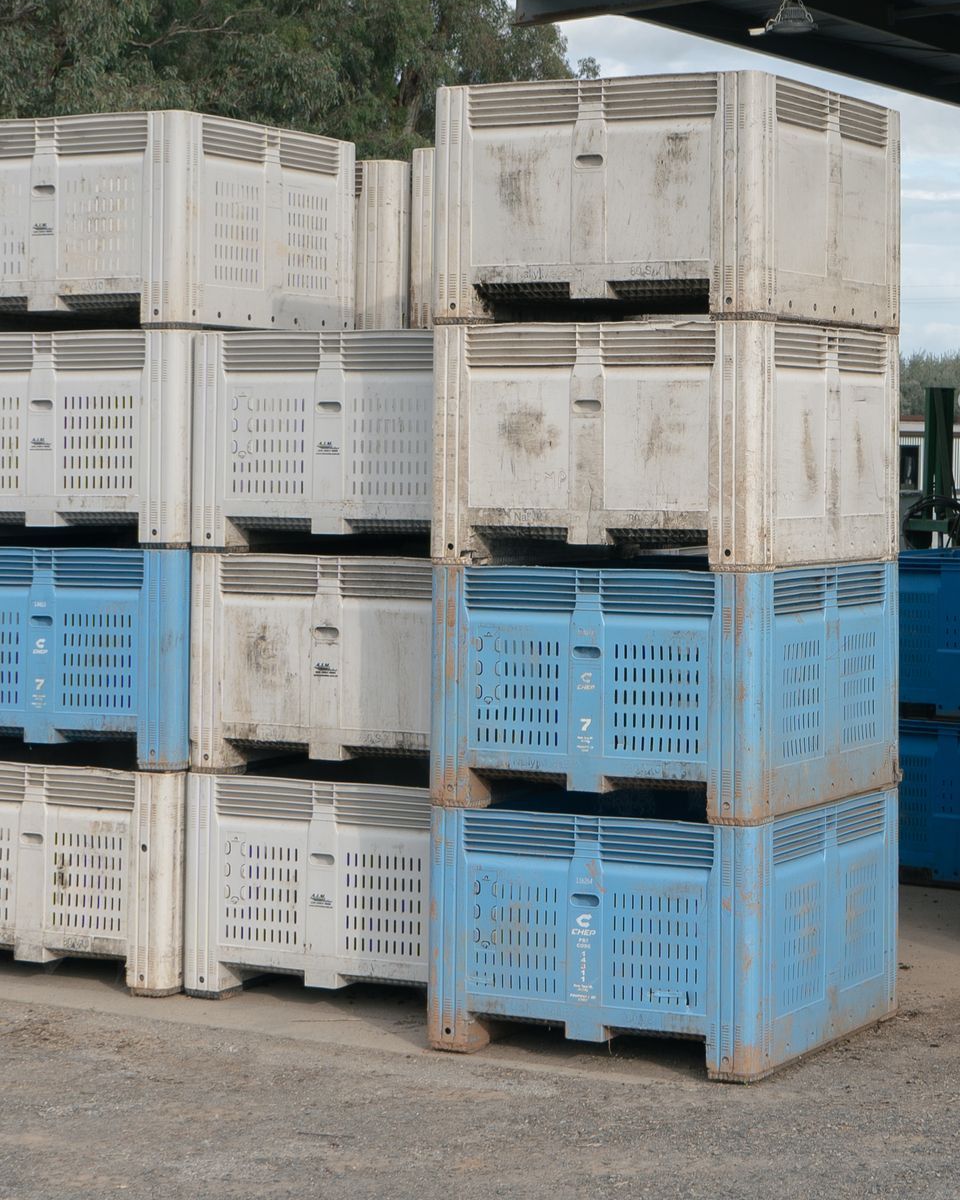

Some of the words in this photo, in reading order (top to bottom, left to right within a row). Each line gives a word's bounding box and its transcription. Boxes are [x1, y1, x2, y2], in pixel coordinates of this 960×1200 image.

[34, 679, 45, 690] 7
[580, 718, 592, 731] 7
[571, 928, 596, 936] CHEP
